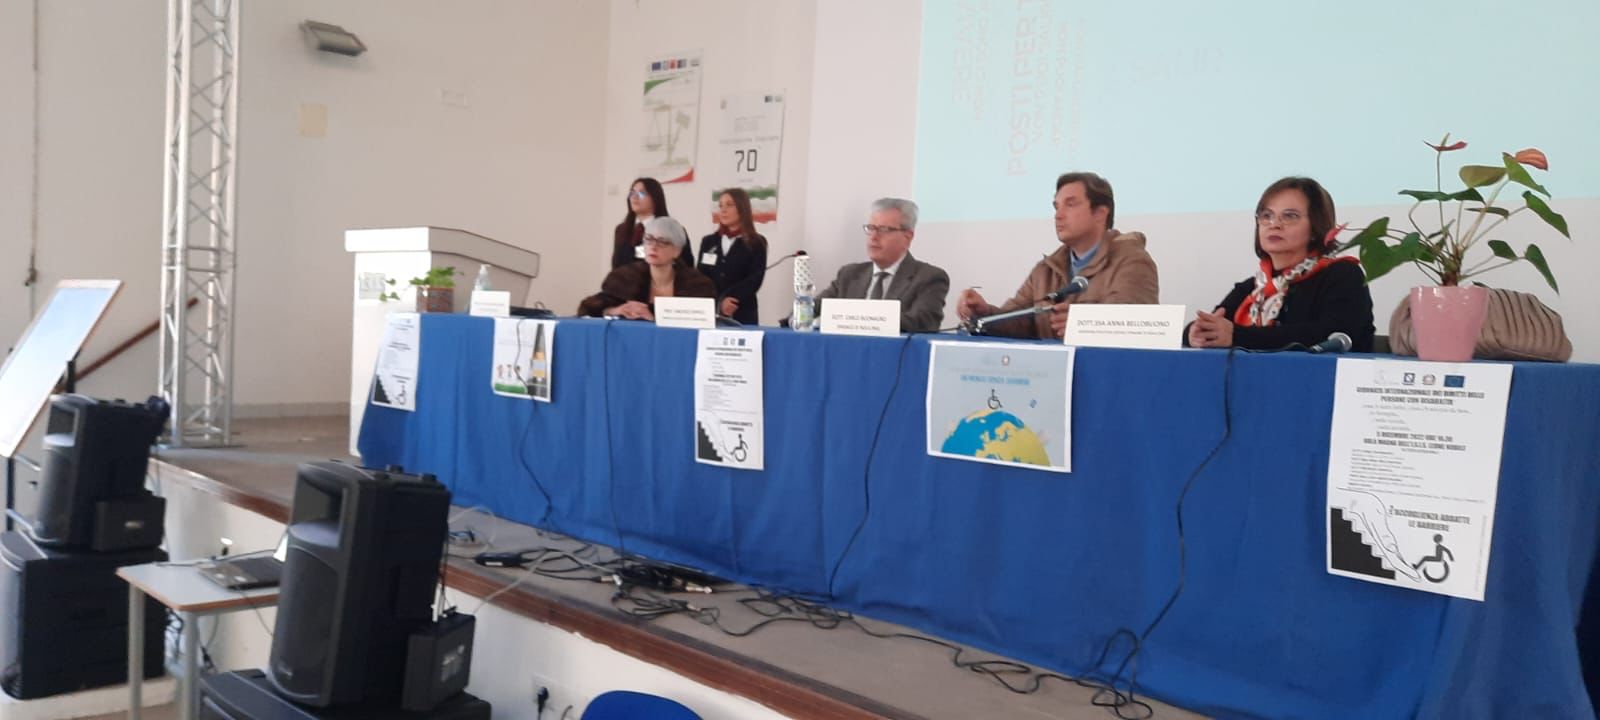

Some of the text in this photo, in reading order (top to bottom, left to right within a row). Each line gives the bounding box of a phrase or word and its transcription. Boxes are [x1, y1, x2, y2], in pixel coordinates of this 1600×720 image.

[1013, 16, 1037, 77] PER
[735, 149, 758, 172] 70
[1006, 85, 1033, 176] POSTI
